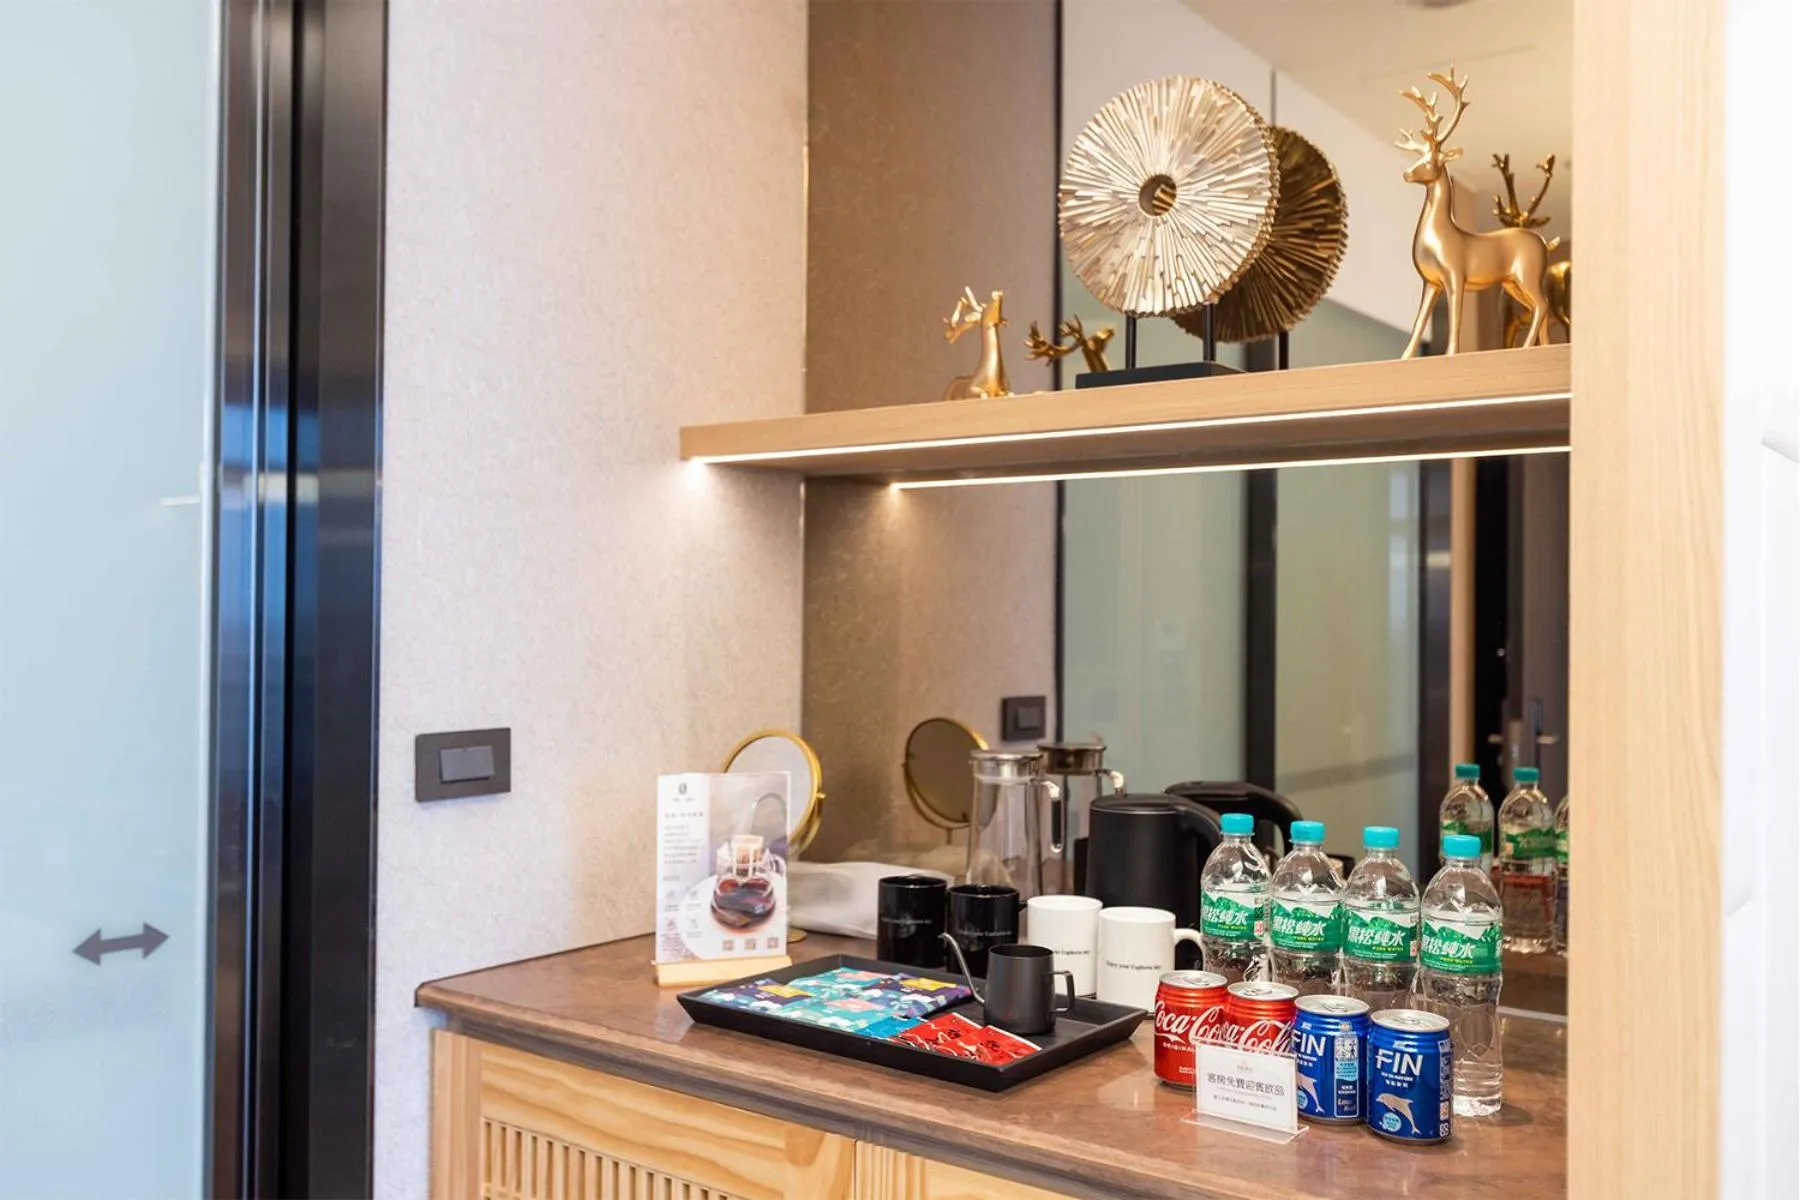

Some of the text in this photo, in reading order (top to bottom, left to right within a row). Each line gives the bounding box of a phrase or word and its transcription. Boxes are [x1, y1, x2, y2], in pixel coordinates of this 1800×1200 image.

[1347, 926, 1407, 946] 黑松純水
[1291, 1029, 1326, 1056] FIN
[1375, 1048, 1424, 1076] FIN
